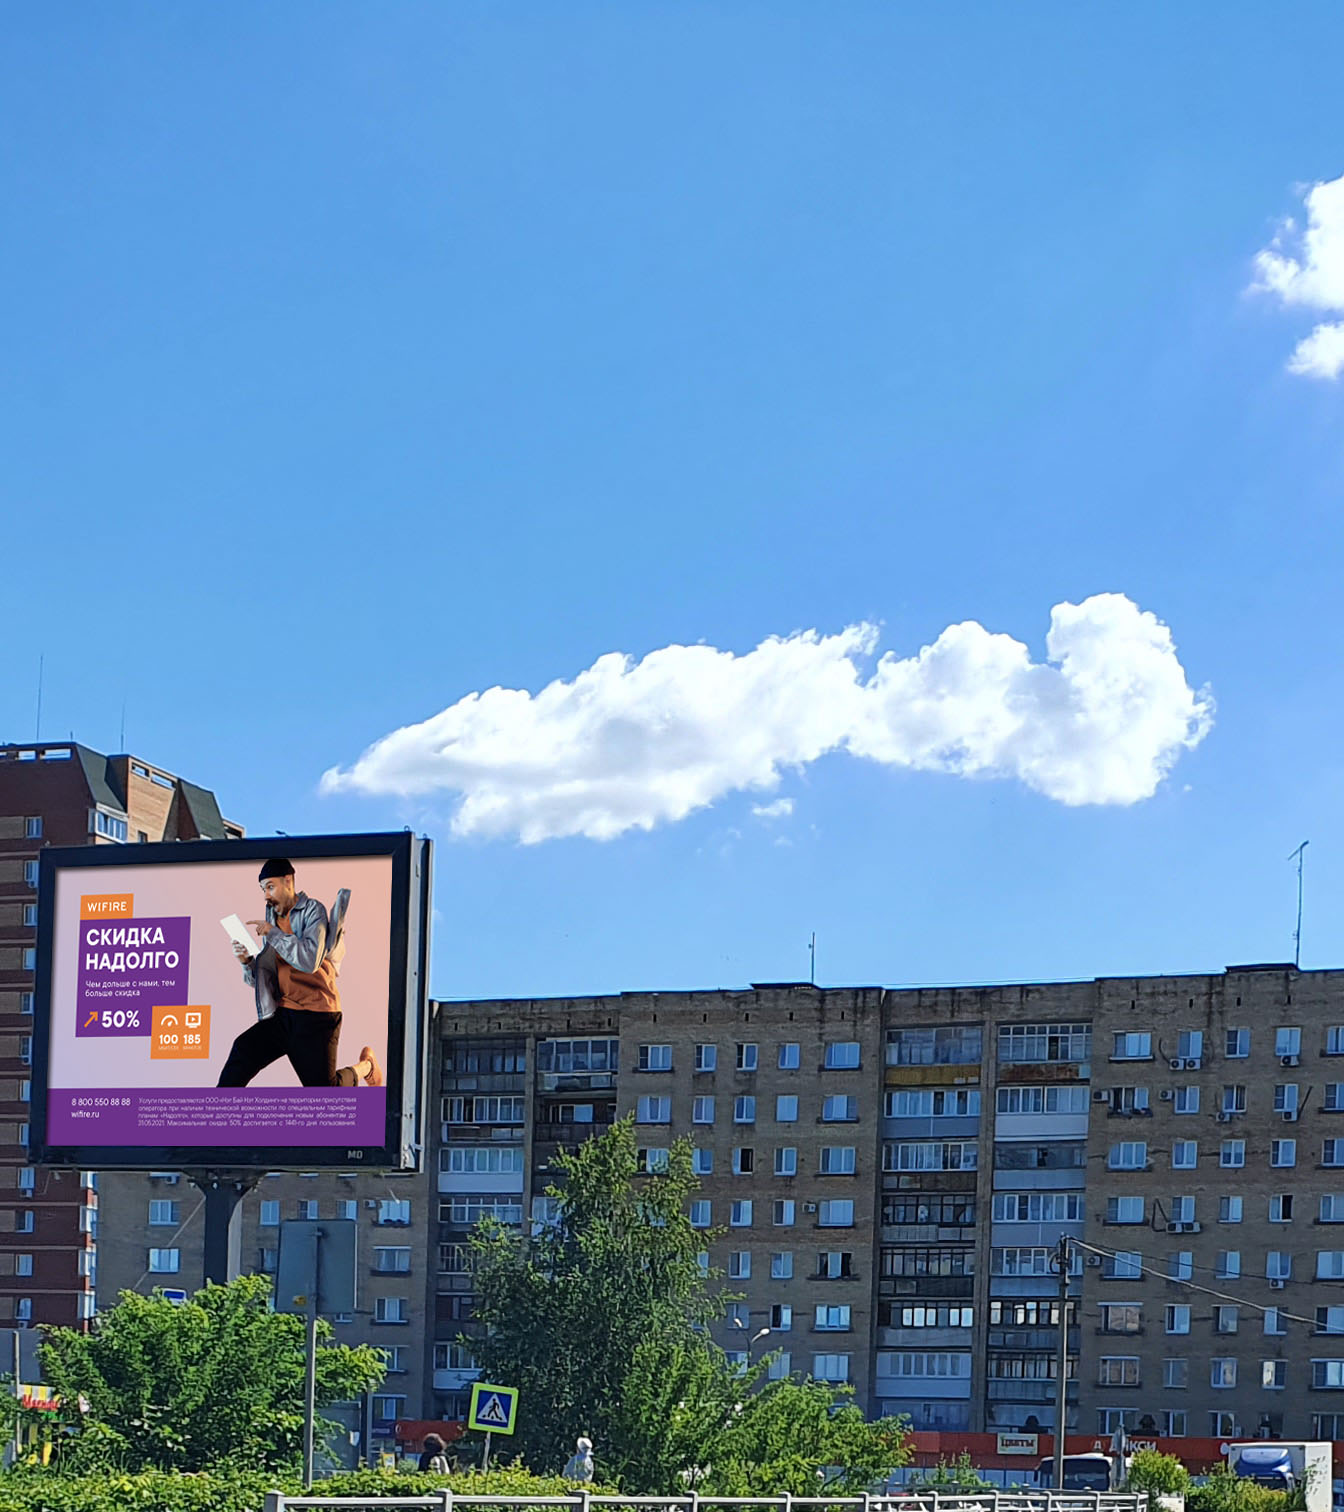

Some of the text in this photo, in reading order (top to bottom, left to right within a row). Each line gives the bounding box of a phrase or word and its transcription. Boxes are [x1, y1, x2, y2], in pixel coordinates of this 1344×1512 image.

[87, 901, 127, 912] WIFIRE
[86, 927, 165, 948] СКИДКА
[85, 951, 179, 973] НАДОЛГО
[102, 981, 130, 989] дольше
[85, 989, 141, 997] больше скидка
[101, 1010, 140, 1028] 50%
[159, 1034, 178, 1045] 100
[183, 1034, 201, 1045] 185
[71, 1097, 77, 1106] 8
[78, 1097, 93, 1106] 800
